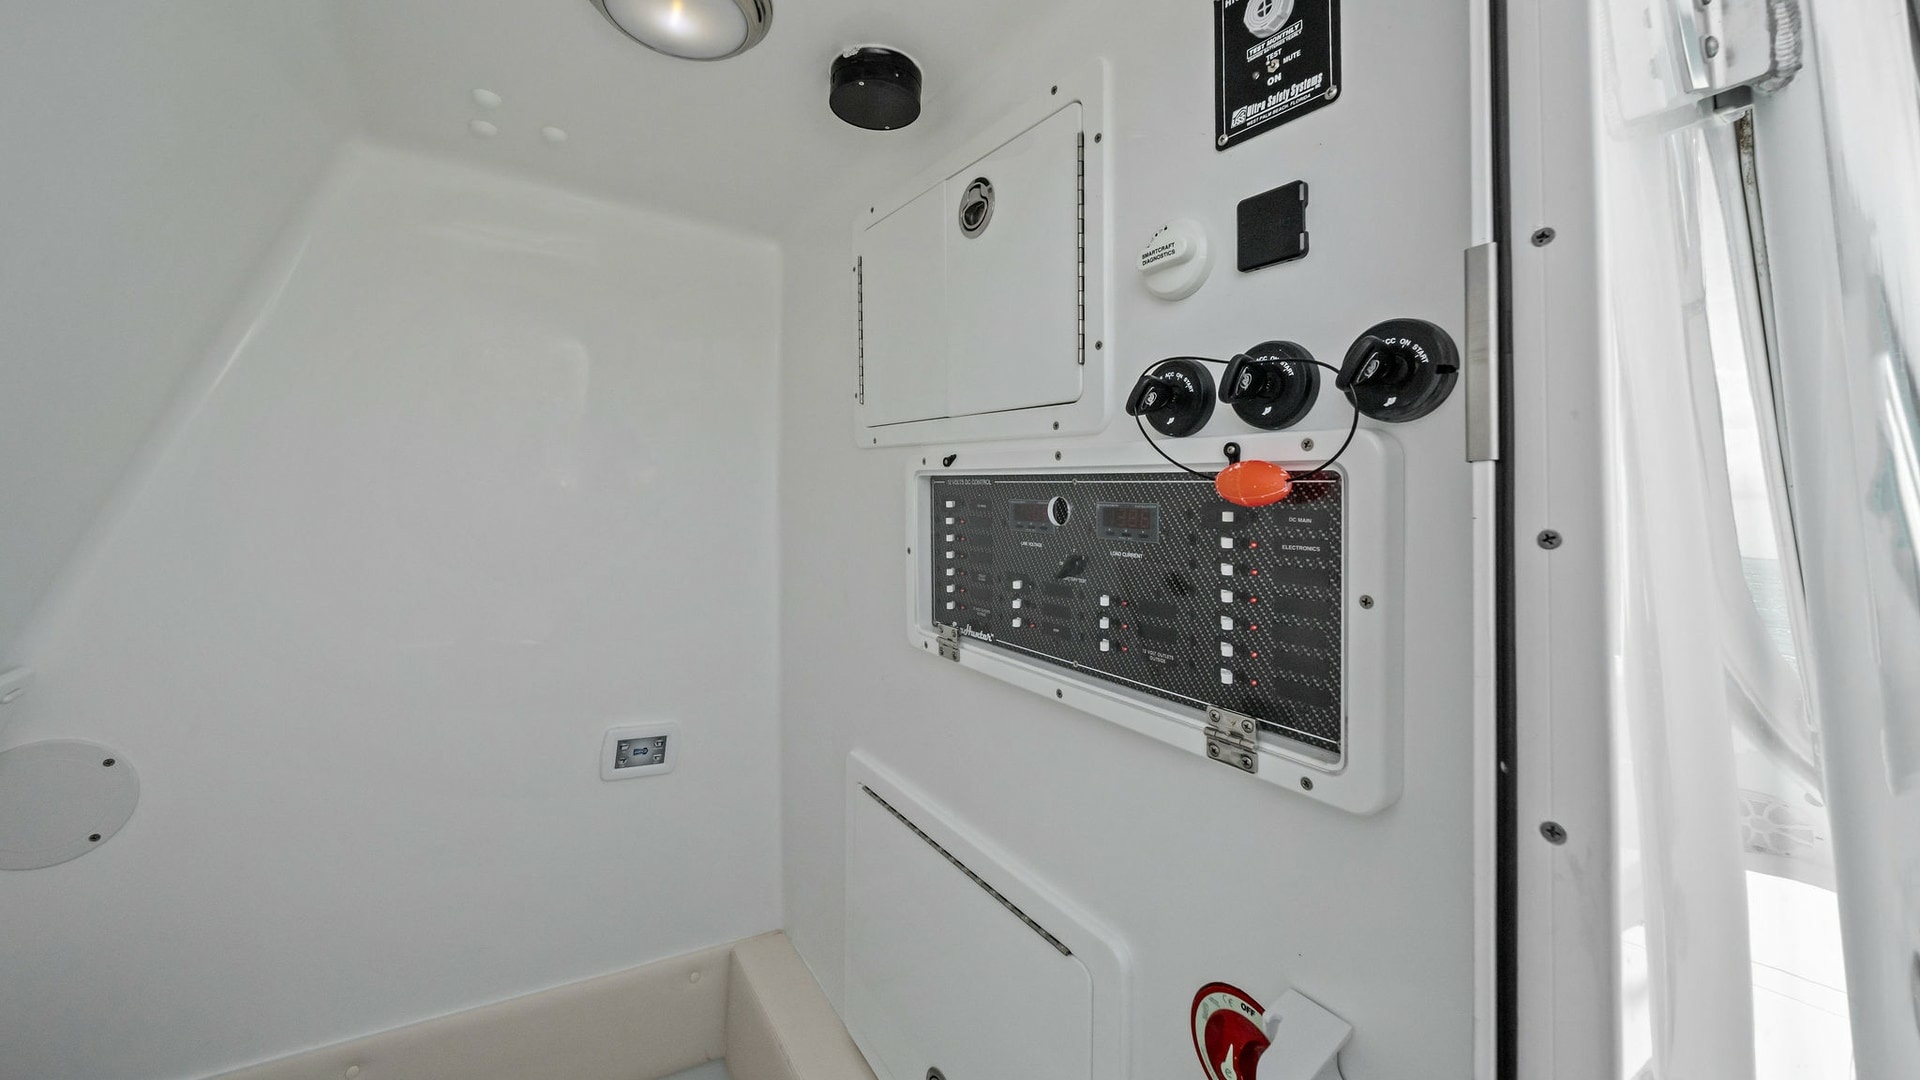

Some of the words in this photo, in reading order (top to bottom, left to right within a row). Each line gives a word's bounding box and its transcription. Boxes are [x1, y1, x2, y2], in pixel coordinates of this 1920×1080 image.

[1249, 42, 1266, 56] TEST
[1266, 23, 1300, 47] MONTHLY
[1266, 48, 1282, 61] TEST
[1282, 49, 1301, 64] MUTE
[1267, 72, 1282, 86] ON
[1246, 100, 1266, 117] Ultra
[1267, 88, 1290, 107] Safety
[1290, 72, 1323, 97] Systems
[1290, 93, 1311, 107] FLORIDA
[1141, 241, 1176, 260] SMARTCRAFT
[1141, 249, 1176, 266] DIAGNOSTICS
[1399, 338, 1411, 347] ON
[1411, 343, 1429, 364] START
[1279, 361, 1295, 376] START
[1164, 371, 1175, 379] ACC
[1183, 377, 1194, 393] START
[1122, 551, 1143, 559] CURRENT
[1281, 544, 1321, 552] ELECTRONICS
[1240, 1002, 1256, 1017] OFF
